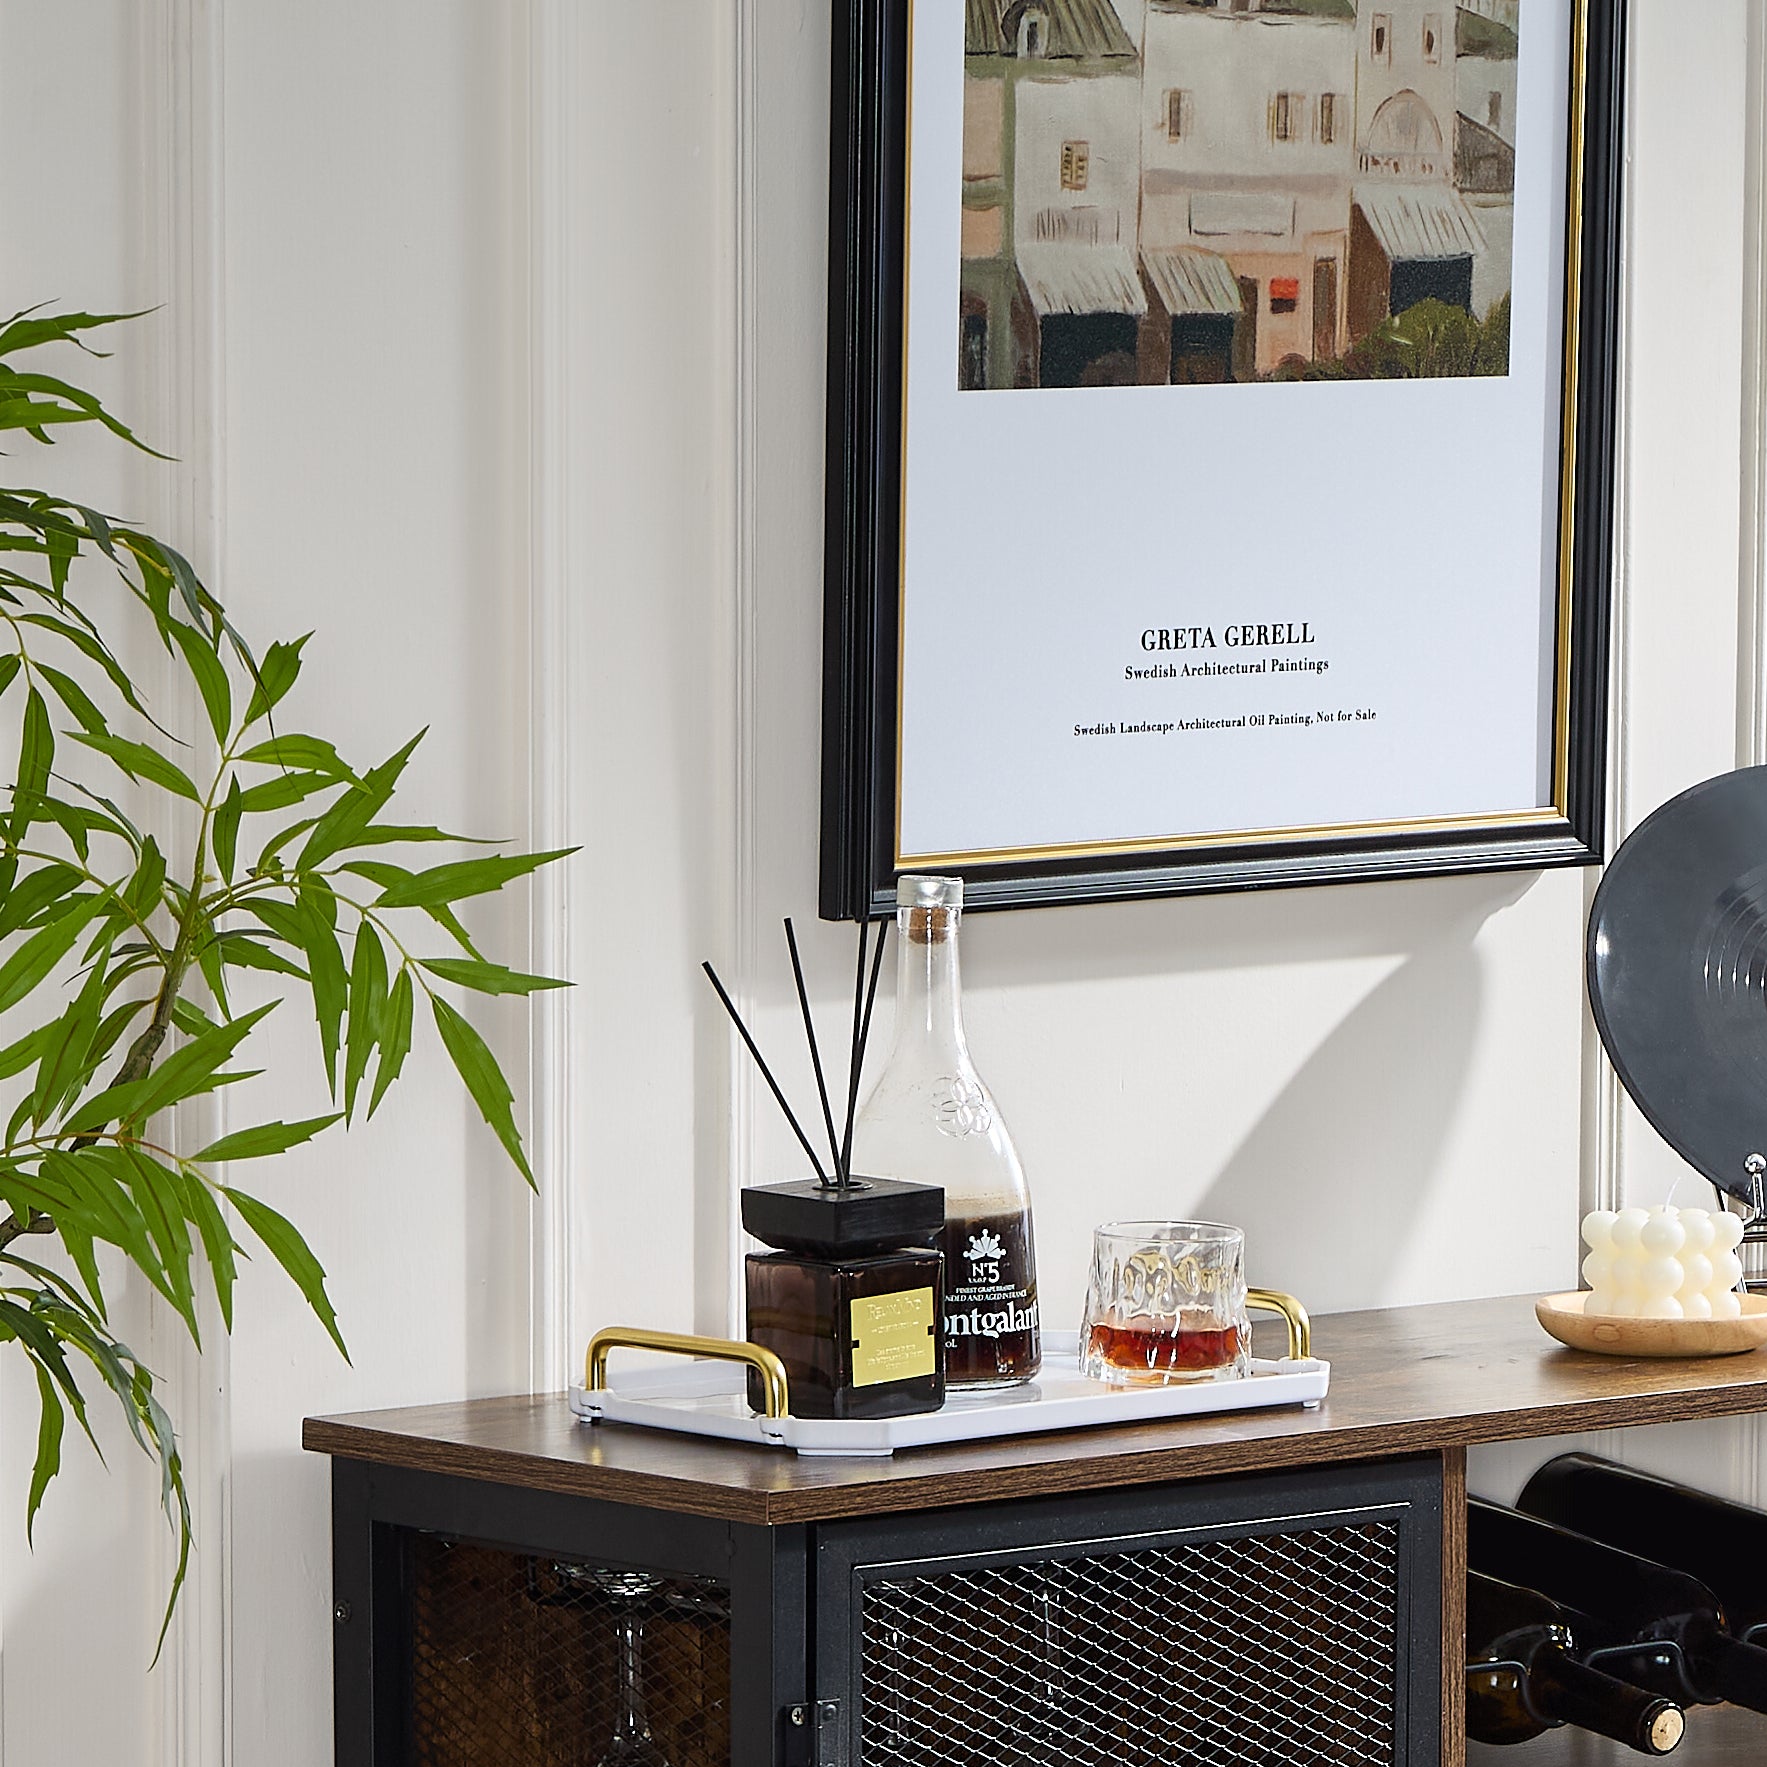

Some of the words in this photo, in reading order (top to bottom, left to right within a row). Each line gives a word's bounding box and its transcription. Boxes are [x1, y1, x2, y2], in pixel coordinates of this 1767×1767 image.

[1141, 627, 1217, 651] GRETA
[1224, 623, 1315, 647] GERELL
[1125, 664, 1177, 680] Swedish
[1181, 659, 1267, 677] Architectural
[1271, 657, 1329, 675] Paintings
[1074, 722, 1116, 736] Swedish
[1120, 721, 1174, 735] Landscape
[1177, 716, 1246, 731] Architectural
[1249, 714, 1265, 727] Oil
[1316, 711, 1334, 723] Not
[1337, 710, 1353, 722] for
[1355, 708, 1377, 721] Sale
